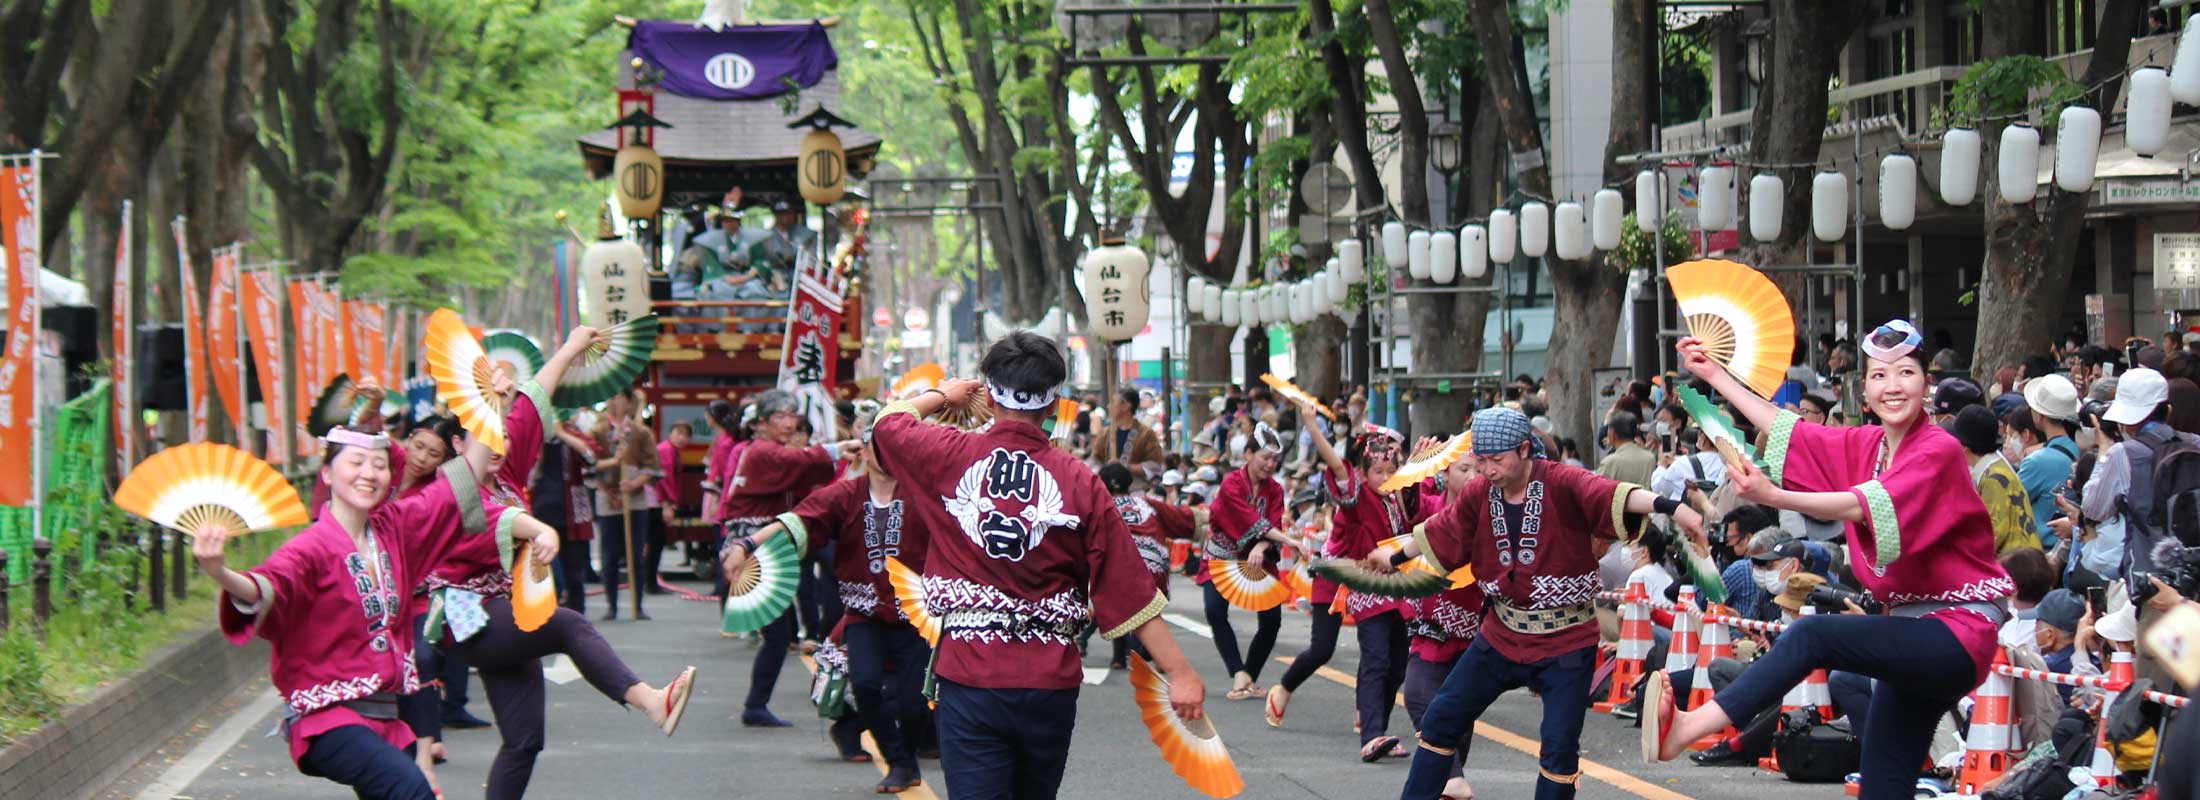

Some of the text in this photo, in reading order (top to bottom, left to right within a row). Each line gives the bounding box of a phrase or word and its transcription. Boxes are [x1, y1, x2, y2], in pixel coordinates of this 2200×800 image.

[602, 262, 627, 325] 仙台市
[1101, 265, 1125, 327] 仙台市
[980, 447, 1038, 562] 仙台
